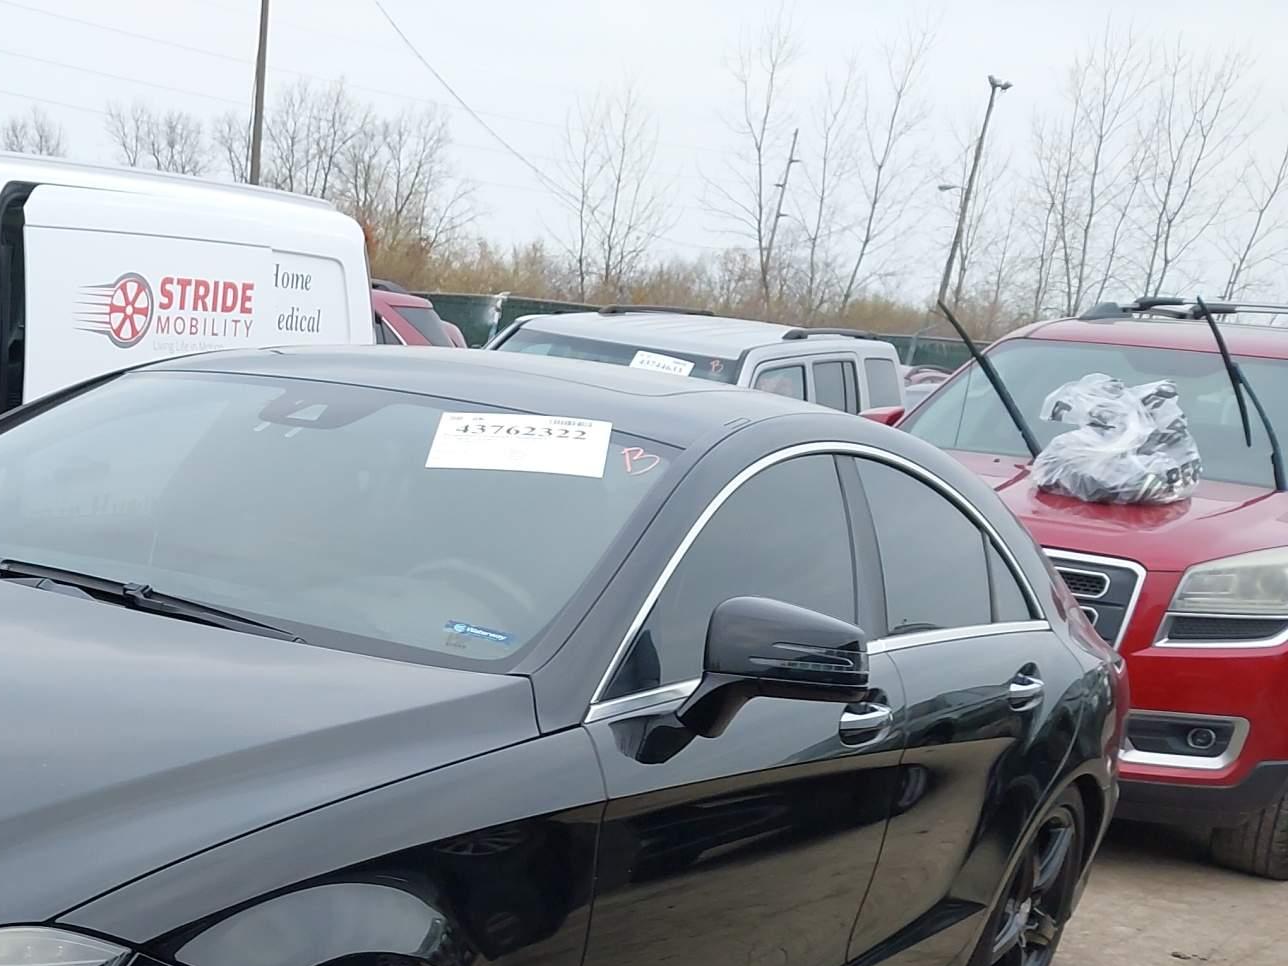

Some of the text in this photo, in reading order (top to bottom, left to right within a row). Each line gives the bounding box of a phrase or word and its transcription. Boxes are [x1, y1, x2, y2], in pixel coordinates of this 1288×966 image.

[158, 276, 255, 315] STRIDE
[155, 315, 254, 338] MOBILITY
[455, 423, 588, 441] 43762322
